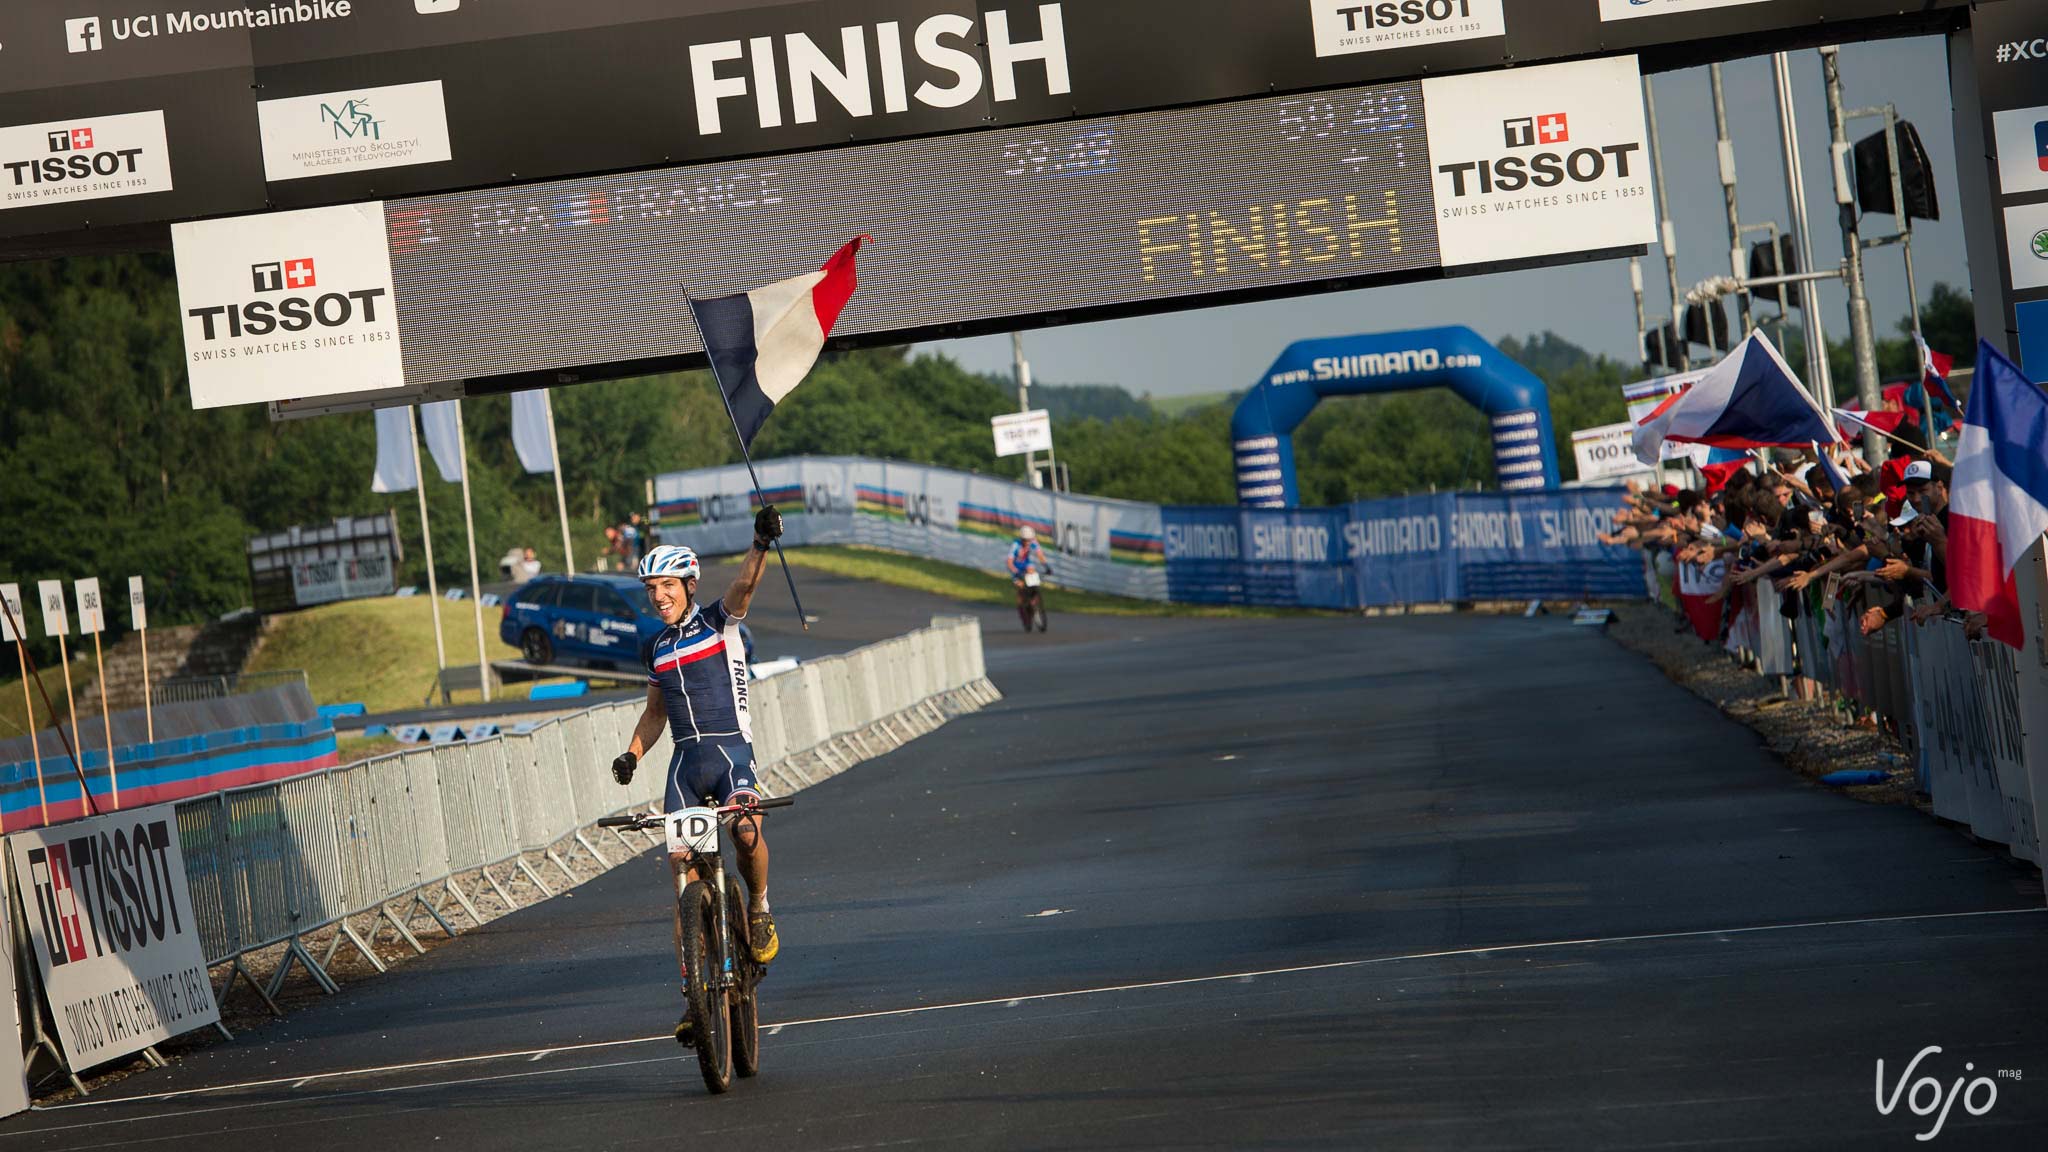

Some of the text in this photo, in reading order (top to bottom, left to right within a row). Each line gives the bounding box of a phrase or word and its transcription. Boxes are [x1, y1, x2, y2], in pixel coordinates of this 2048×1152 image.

[112, 0, 351, 40] UCI Mountainbike
[1339, 23, 1481, 46] SWISS WATCHES SINCE 1853
[689, 3, 1070, 135] FINISH
[1996, 38, 2048, 63] #XC
[4, 148, 143, 186] TISSOT
[292, 145, 367, 161] MINISTERSTVO
[1438, 143, 1639, 197] TISSOT
[7, 178, 147, 200] SWISS WATCHES SINCE 1853
[472, 203, 551, 237] FRA
[615, 172, 783, 220] FRANCE
[1443, 186, 1645, 218] SWISS WATCHES SINCE 1853
[1136, 190, 1402, 282] FINISH
[188, 288, 386, 341] TISSOT
[193, 331, 391, 361] SWISS WATCHES SINCE 1853
[1588, 444, 1618, 461] 100
[1166, 524, 1239, 559] SHIMANO
[1344, 514, 1441, 557] SHIMANO
[732, 659, 748, 713] FRANCE
[69, 820, 182, 957] TISSOT
[64, 997, 104, 1056] SWISS
[98, 982, 156, 1044] WATCHES
[178, 966, 209, 1016] 1853
